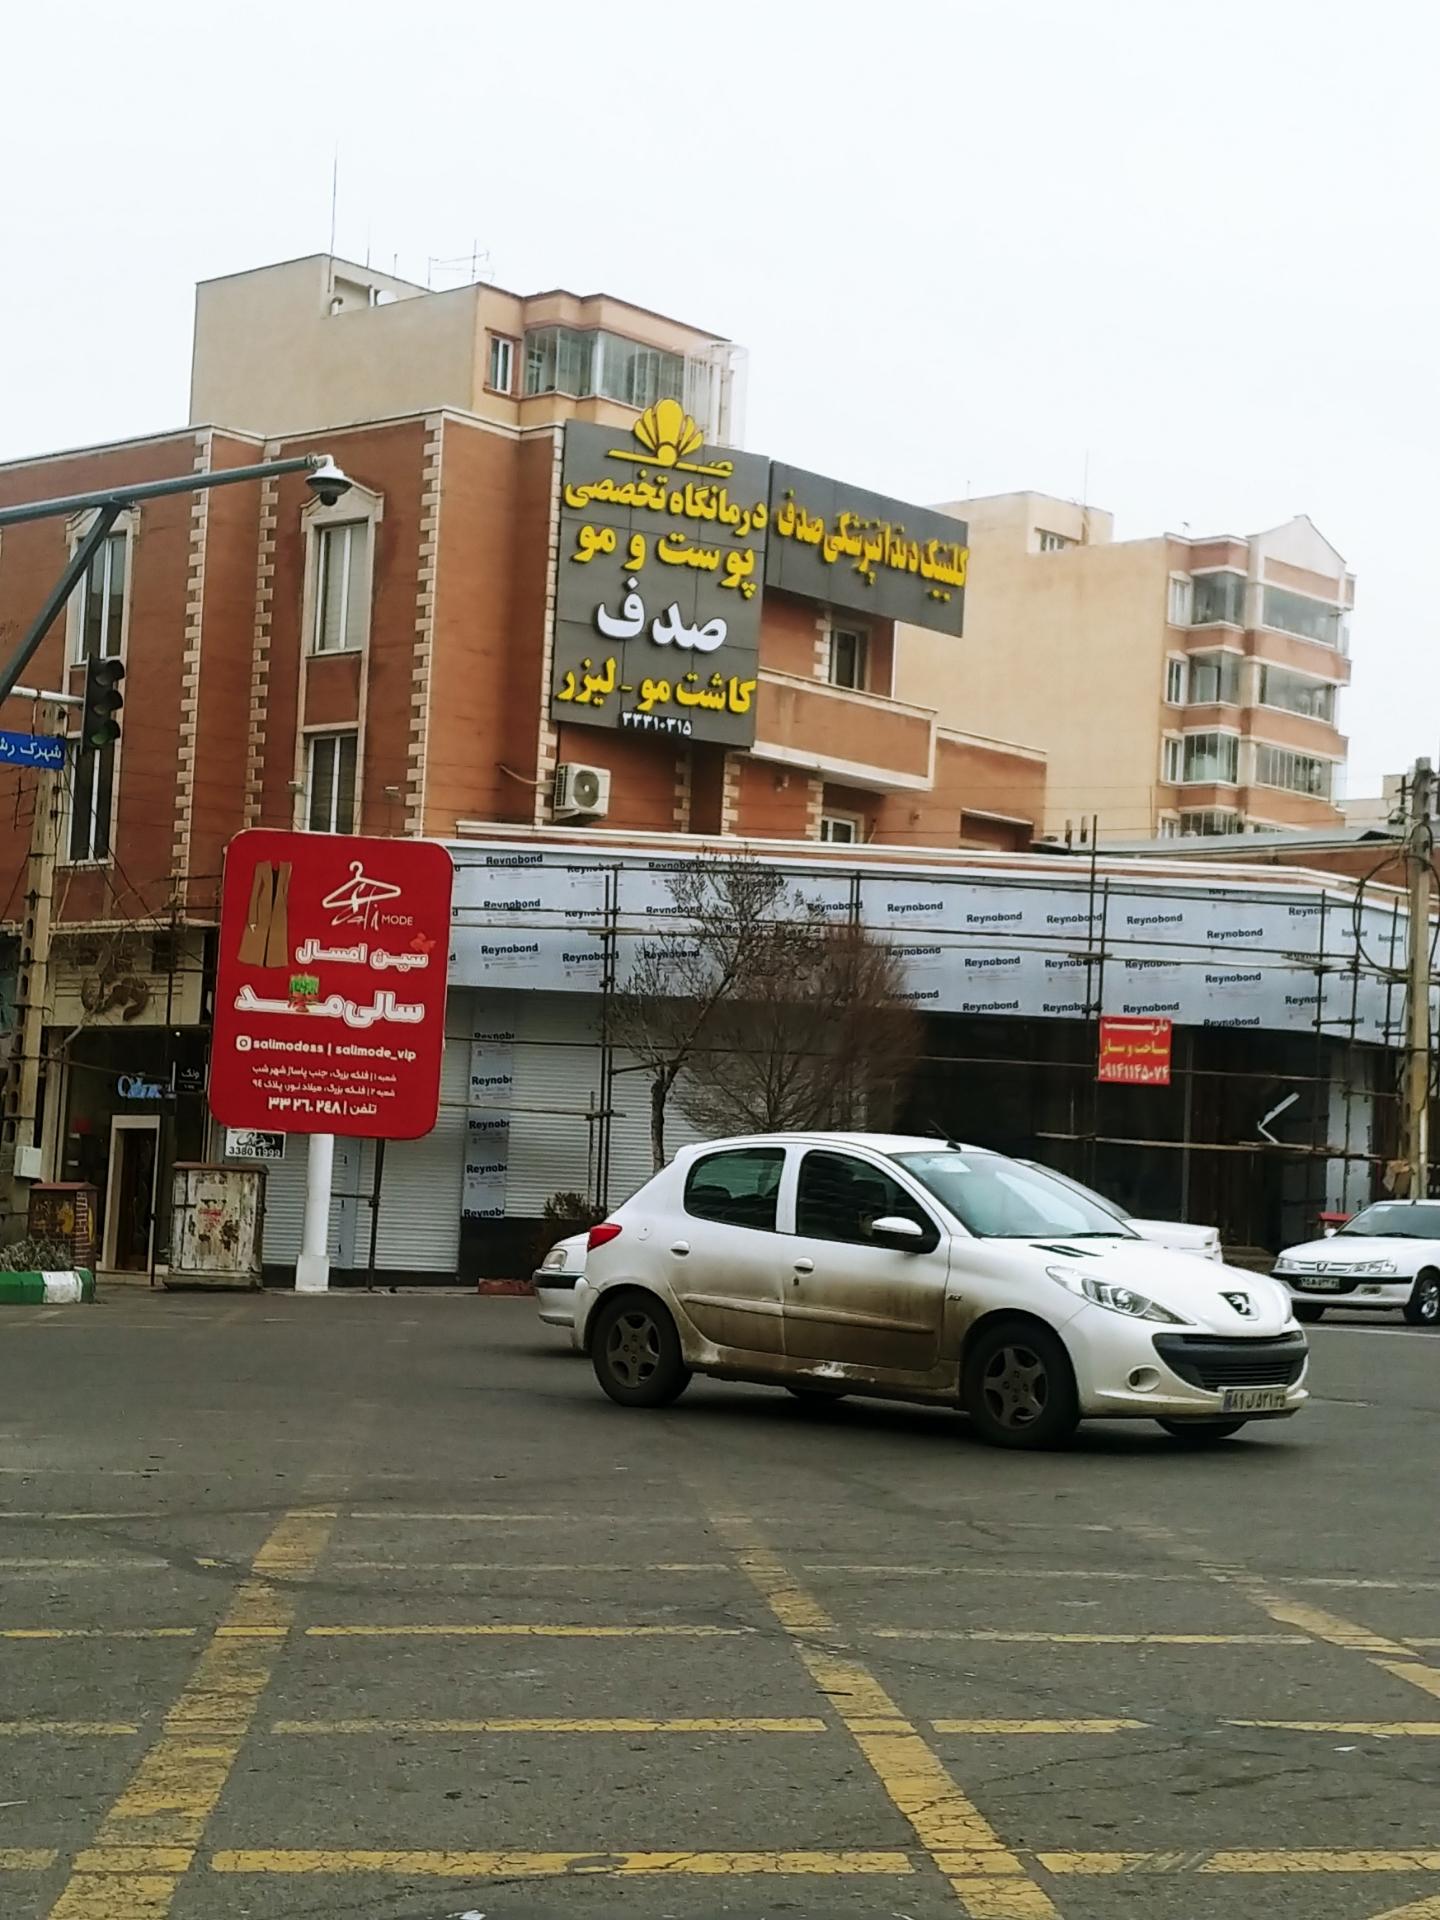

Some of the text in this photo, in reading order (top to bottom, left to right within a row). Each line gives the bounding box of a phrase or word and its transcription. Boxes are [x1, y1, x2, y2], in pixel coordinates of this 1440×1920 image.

[564, 468, 768, 537] درمانگاه تخصصی
[777, 488, 969, 601] کلینیک دندانپزشکی صدف
[571, 524, 757, 599] پوست و مو
[597, 576, 728, 652] صدف
[557, 656, 617, 705] لیزر
[636, 678, 671, 712] مو
[675, 672, 756, 714] کاشت
[20, 742, 62, 762] شهرک
[486, 854, 543, 865] Reynobond
[887, 901, 944, 913] Reynobond
[381, 914, 413, 927] MODE
[966, 912, 1023, 923] Reynobond
[1127, 914, 1183, 926] Reynobond
[1206, 928, 1263, 940] Reynobond
[296, 939, 368, 964] امسال
[481, 943, 539, 955] Reynobond
[965, 956, 1021, 968] Reynobond
[1205, 972, 1262, 984] Reynobond
[343, 991, 425, 1028] سالی
[963, 1000, 1019, 1012] Reynobond
[1123, 1002, 1179, 1014] Reynobond
[253, 1038, 323, 1053] salimodess
[335, 1044, 417, 1062] salimode_vip
[349, 1104, 377, 1115] تلفن
